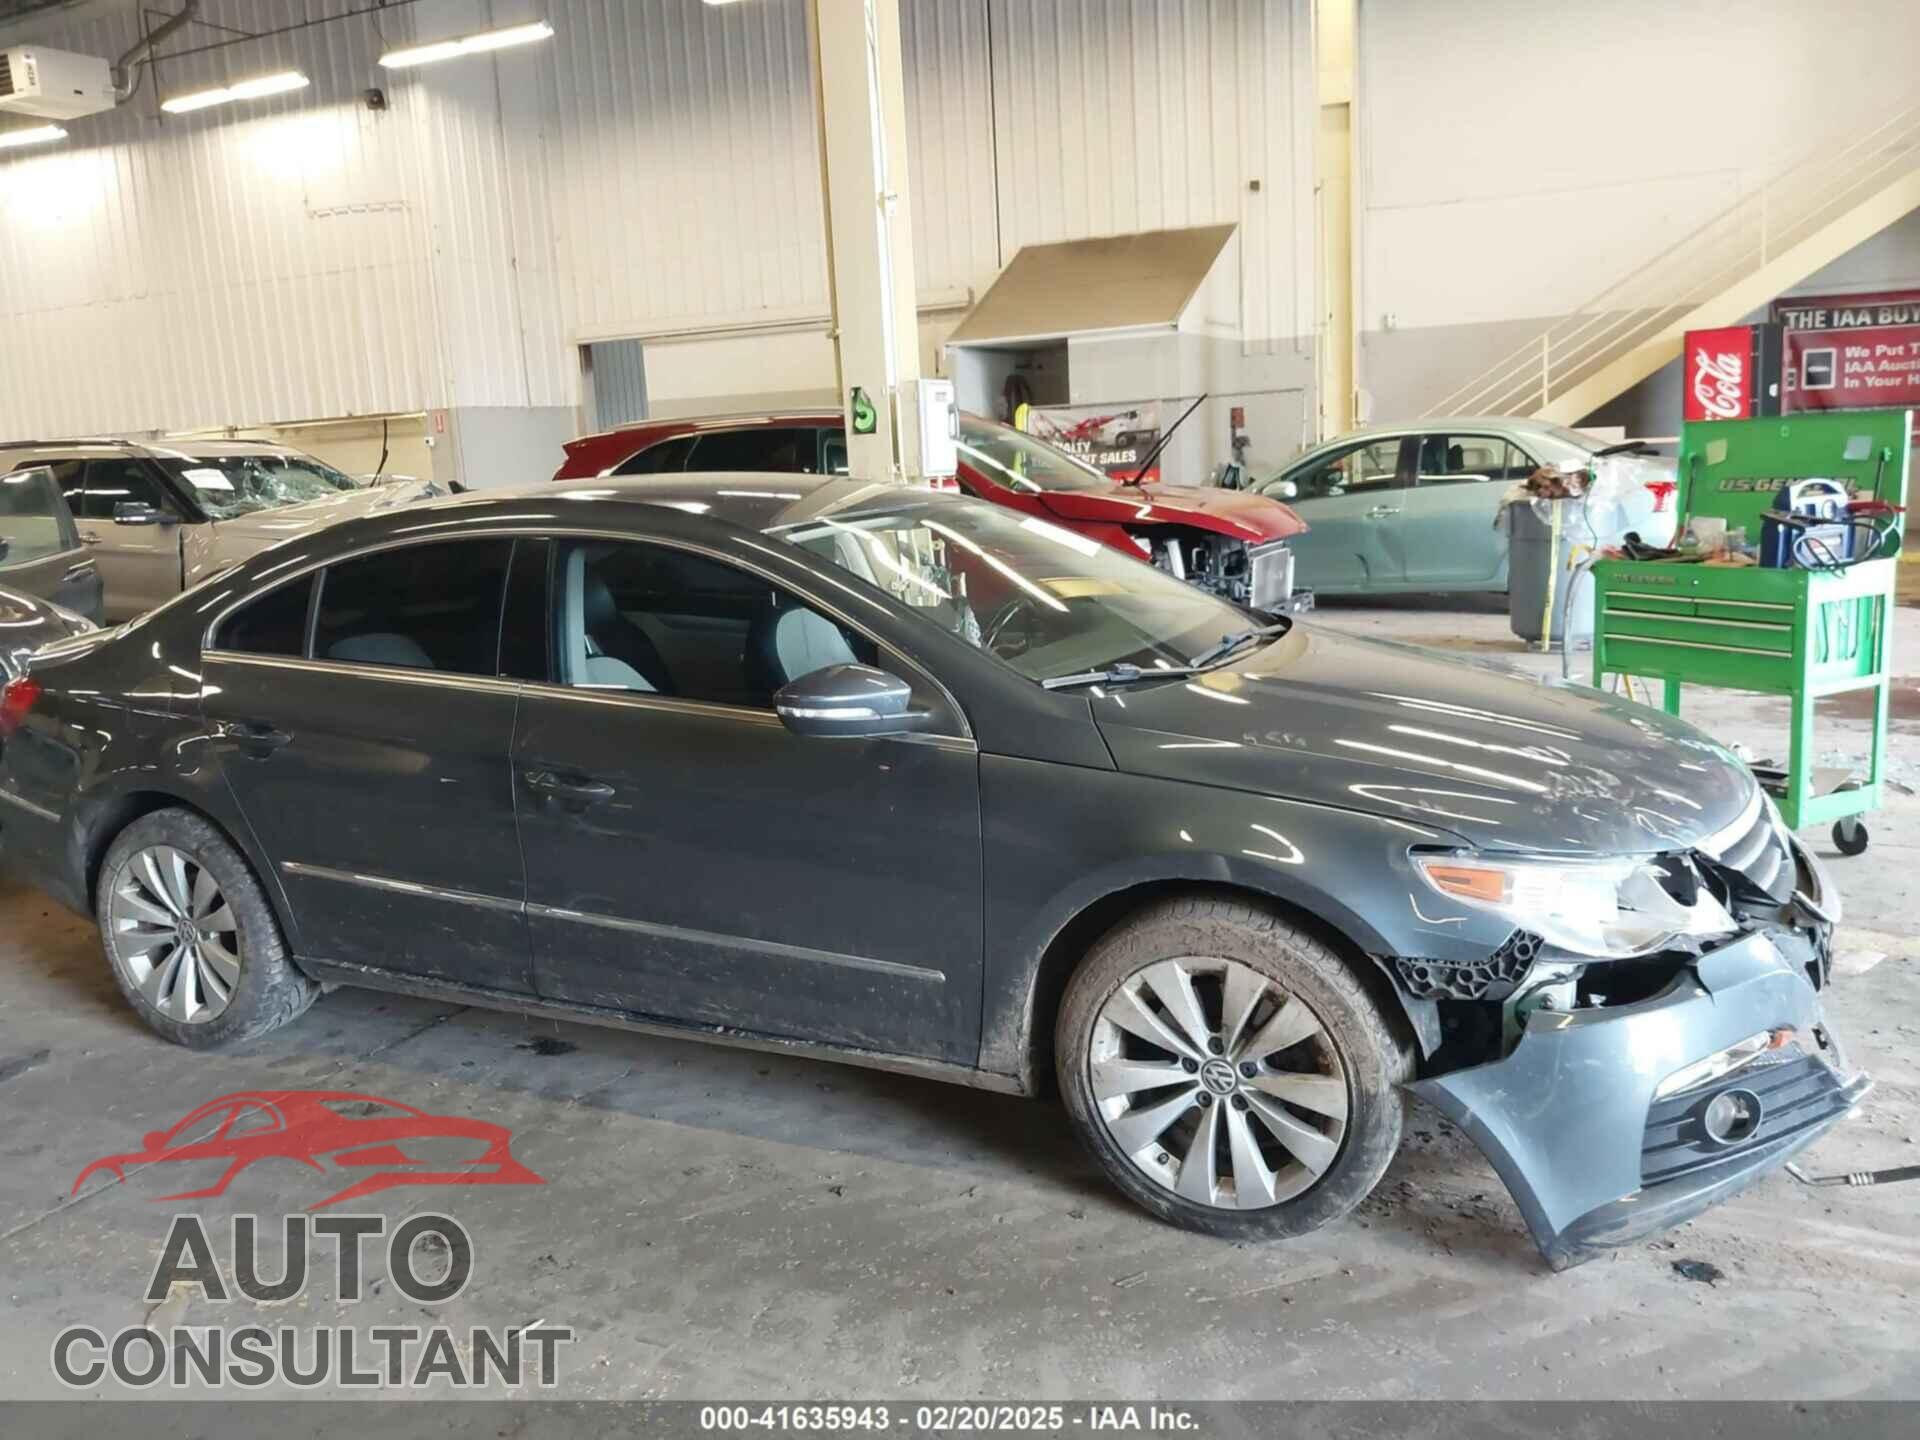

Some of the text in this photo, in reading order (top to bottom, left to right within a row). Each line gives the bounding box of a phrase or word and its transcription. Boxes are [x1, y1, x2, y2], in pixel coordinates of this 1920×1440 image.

[1785, 310, 1826, 329] THE
[1832, 308, 1872, 327] IAA
[1844, 346, 1870, 359] We
[1875, 344, 1904, 357] Put
[1844, 361, 1875, 374] IAA
[1695, 347, 1742, 418] Cola
[1844, 377, 1860, 389] In
[1865, 375, 1902, 388] Your
[1100, 449, 1137, 464] SALES
